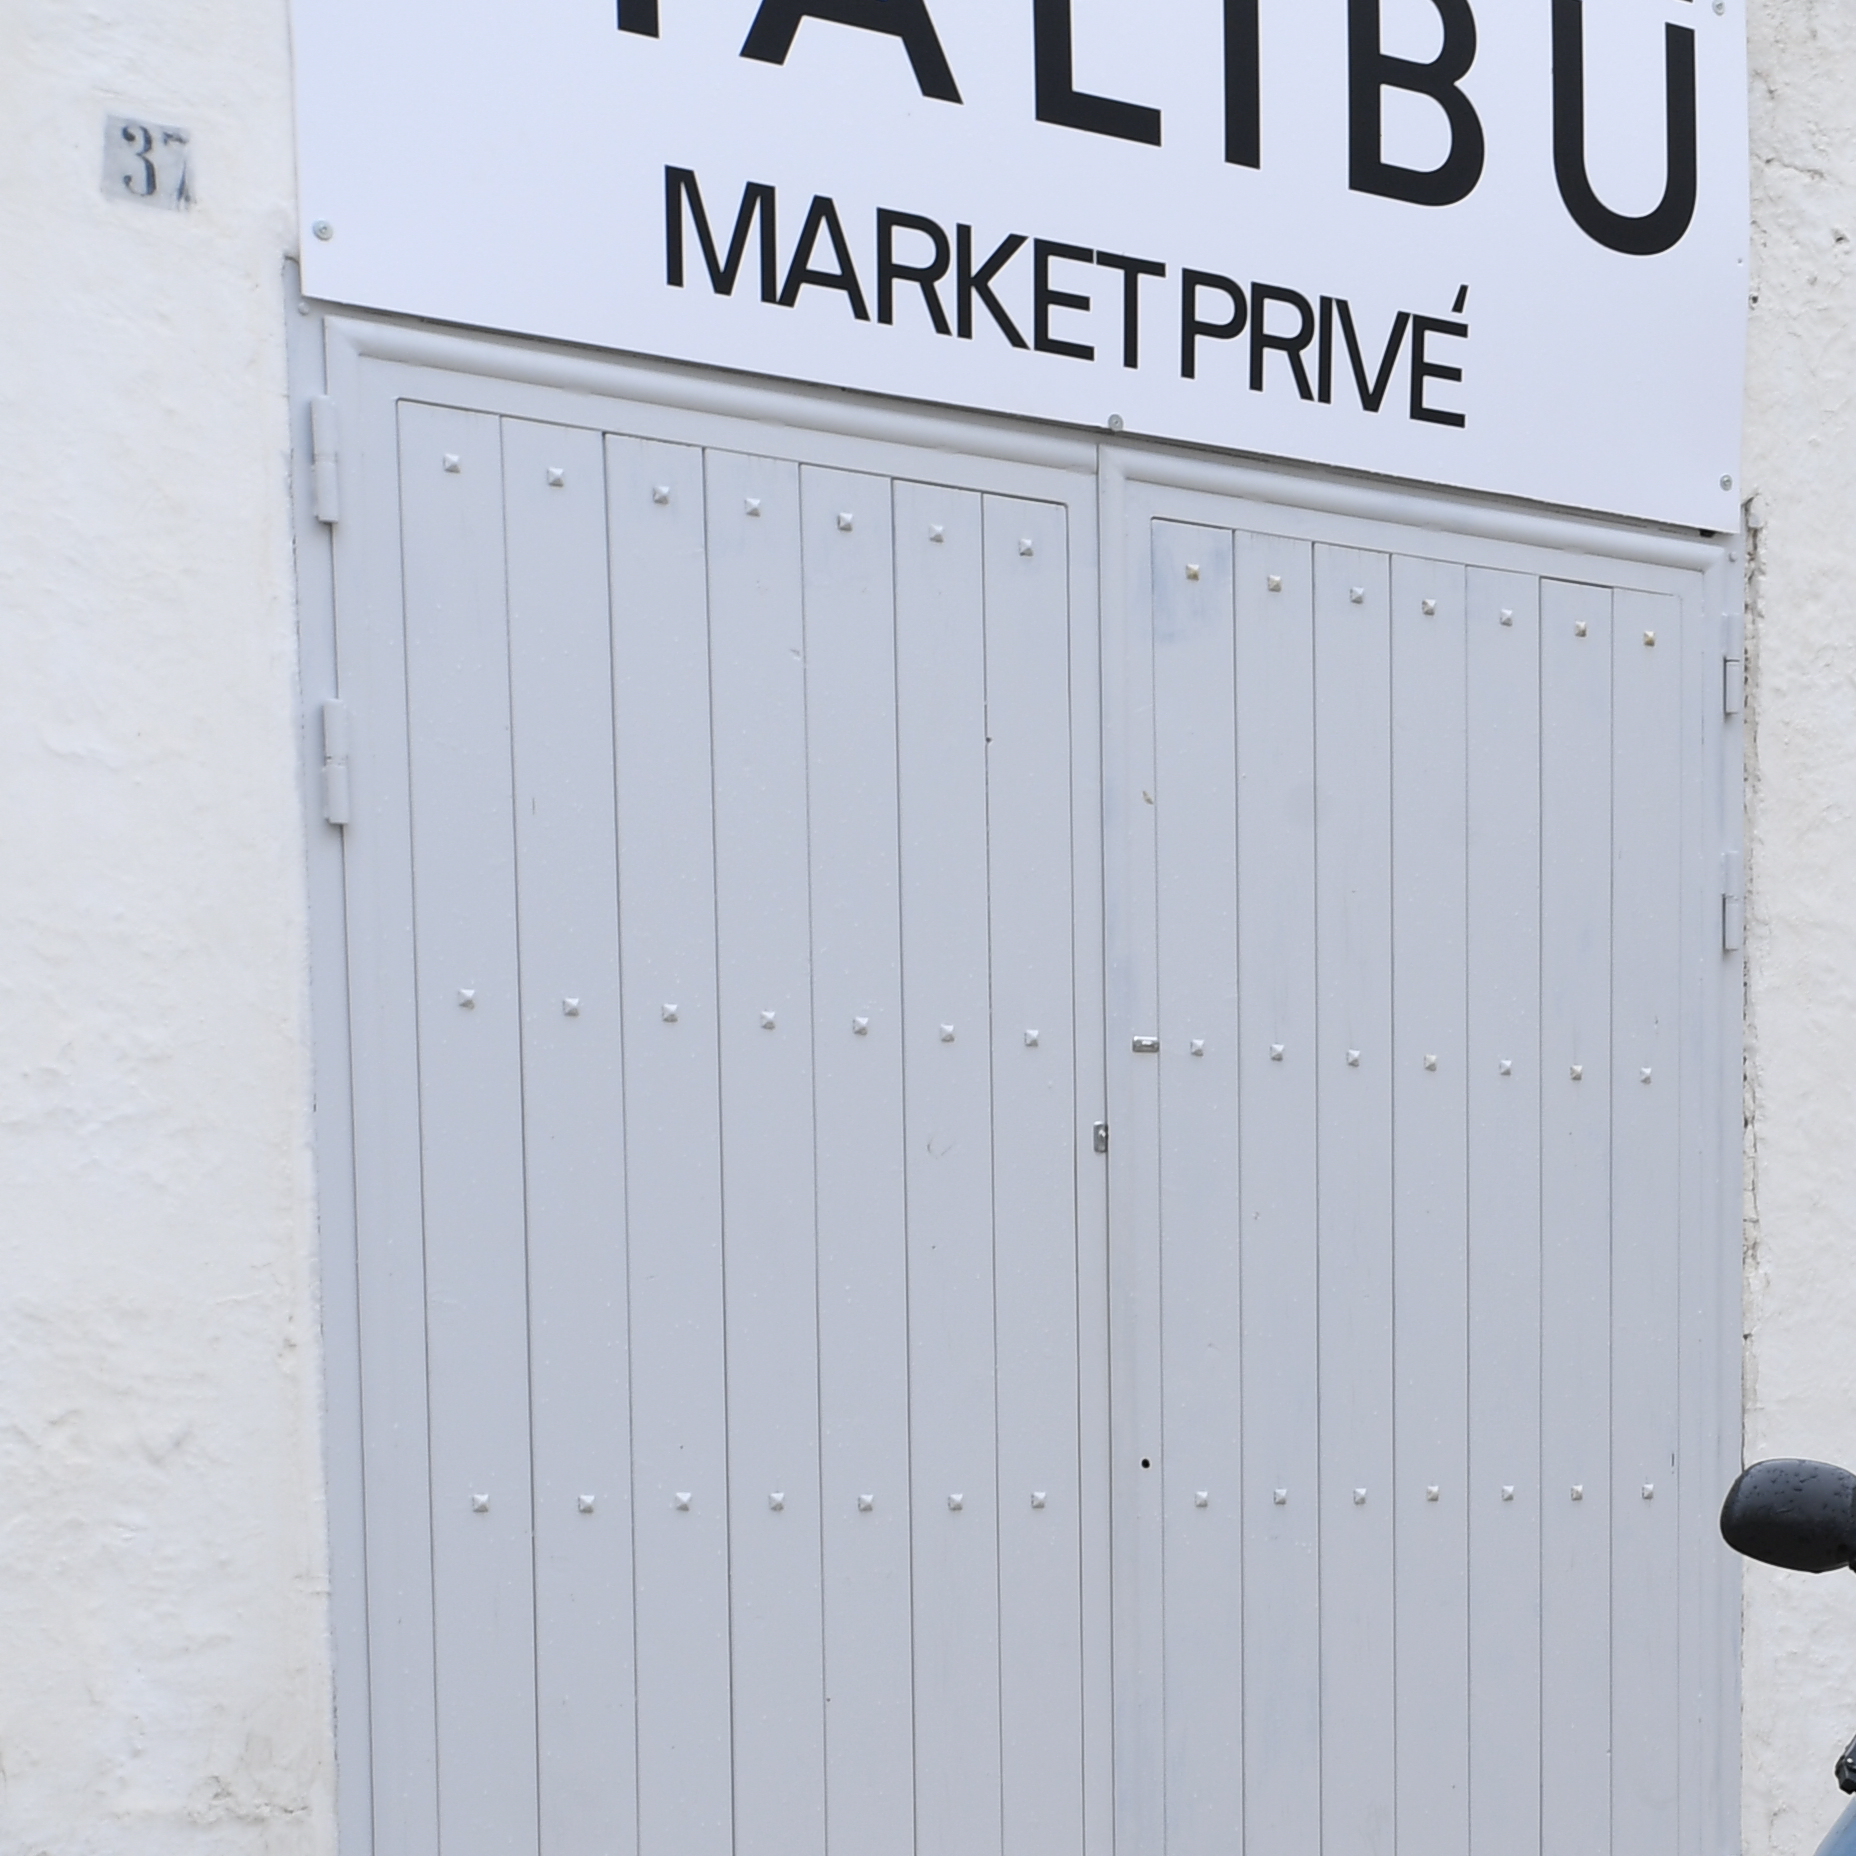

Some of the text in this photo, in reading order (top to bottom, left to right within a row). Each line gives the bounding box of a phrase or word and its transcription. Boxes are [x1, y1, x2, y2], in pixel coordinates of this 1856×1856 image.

[121, 125, 191, 205] 37
[663, 164, 1470, 429] MARKET PRIVÉ
